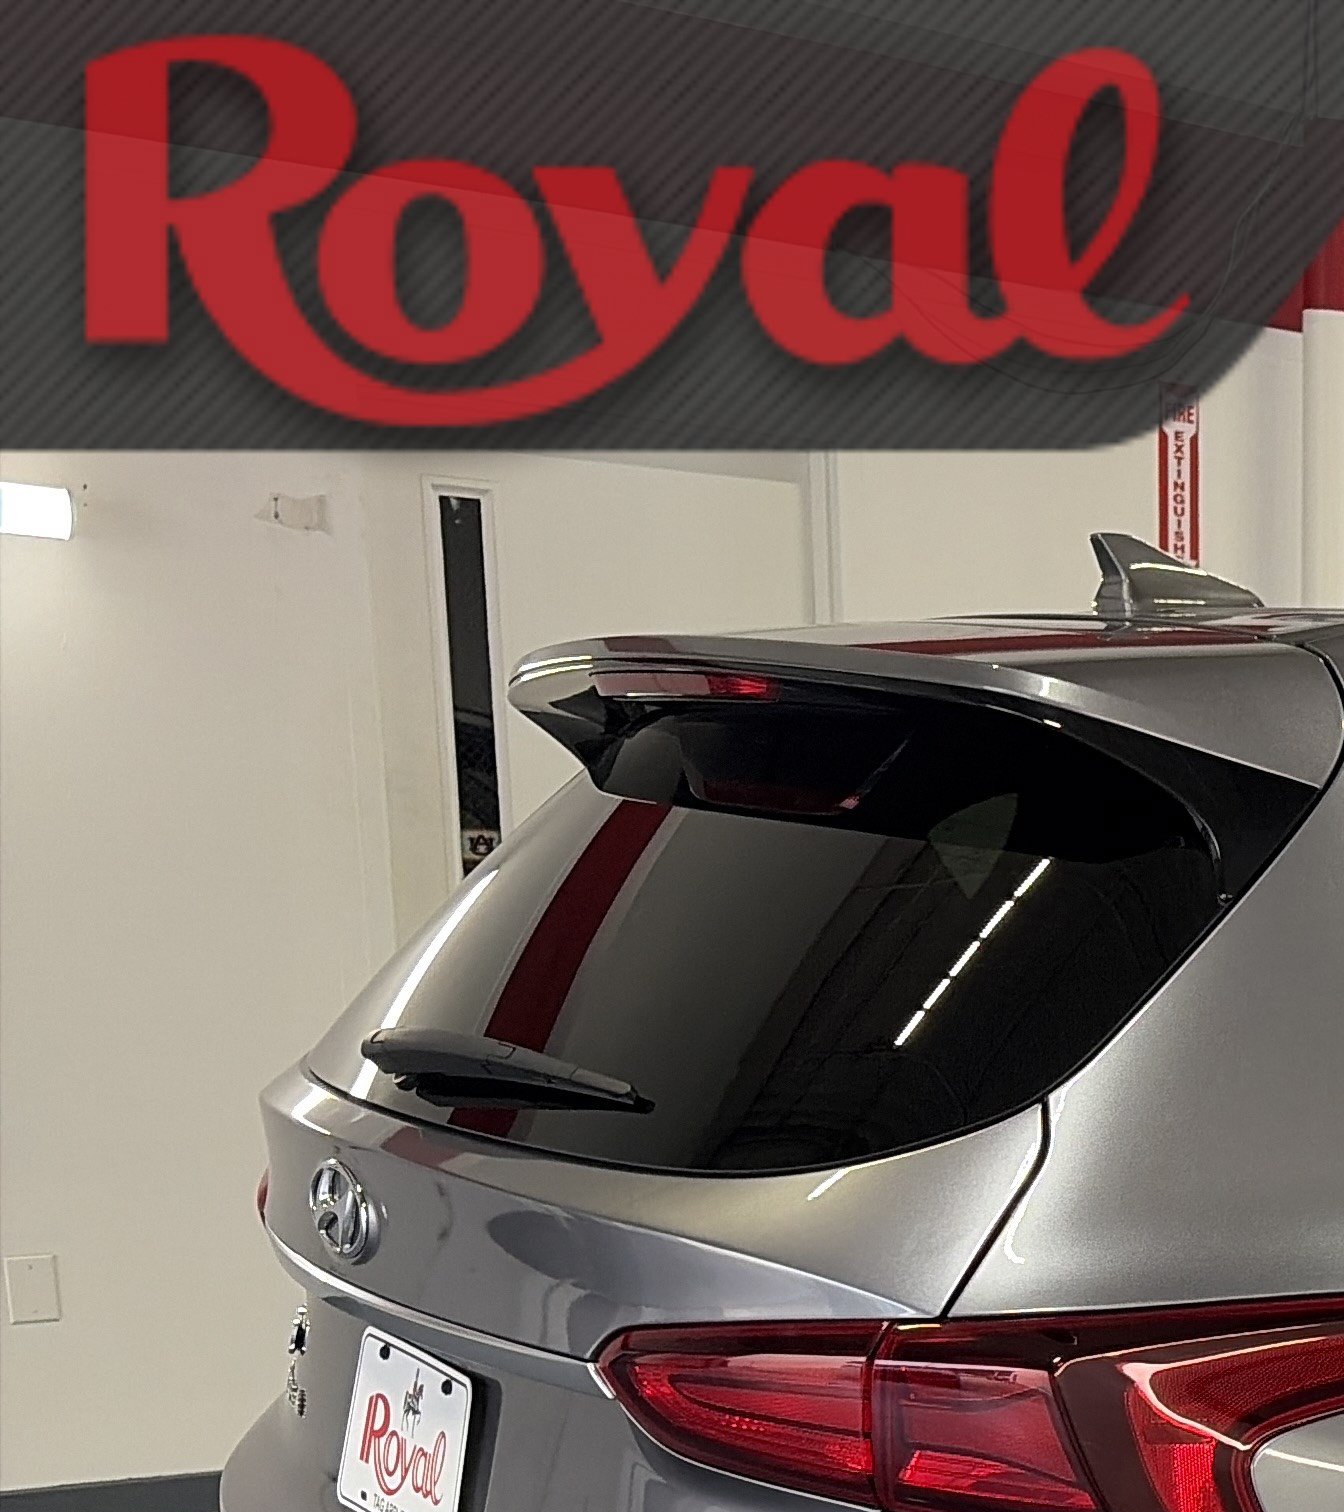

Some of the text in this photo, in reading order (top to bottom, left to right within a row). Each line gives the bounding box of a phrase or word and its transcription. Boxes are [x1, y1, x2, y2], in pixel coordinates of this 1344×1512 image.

[1173, 430, 1186, 559] EXTINGUISH
[359, 1392, 447, 1506] Royal
[373, 1493, 386, 1512] TAG
